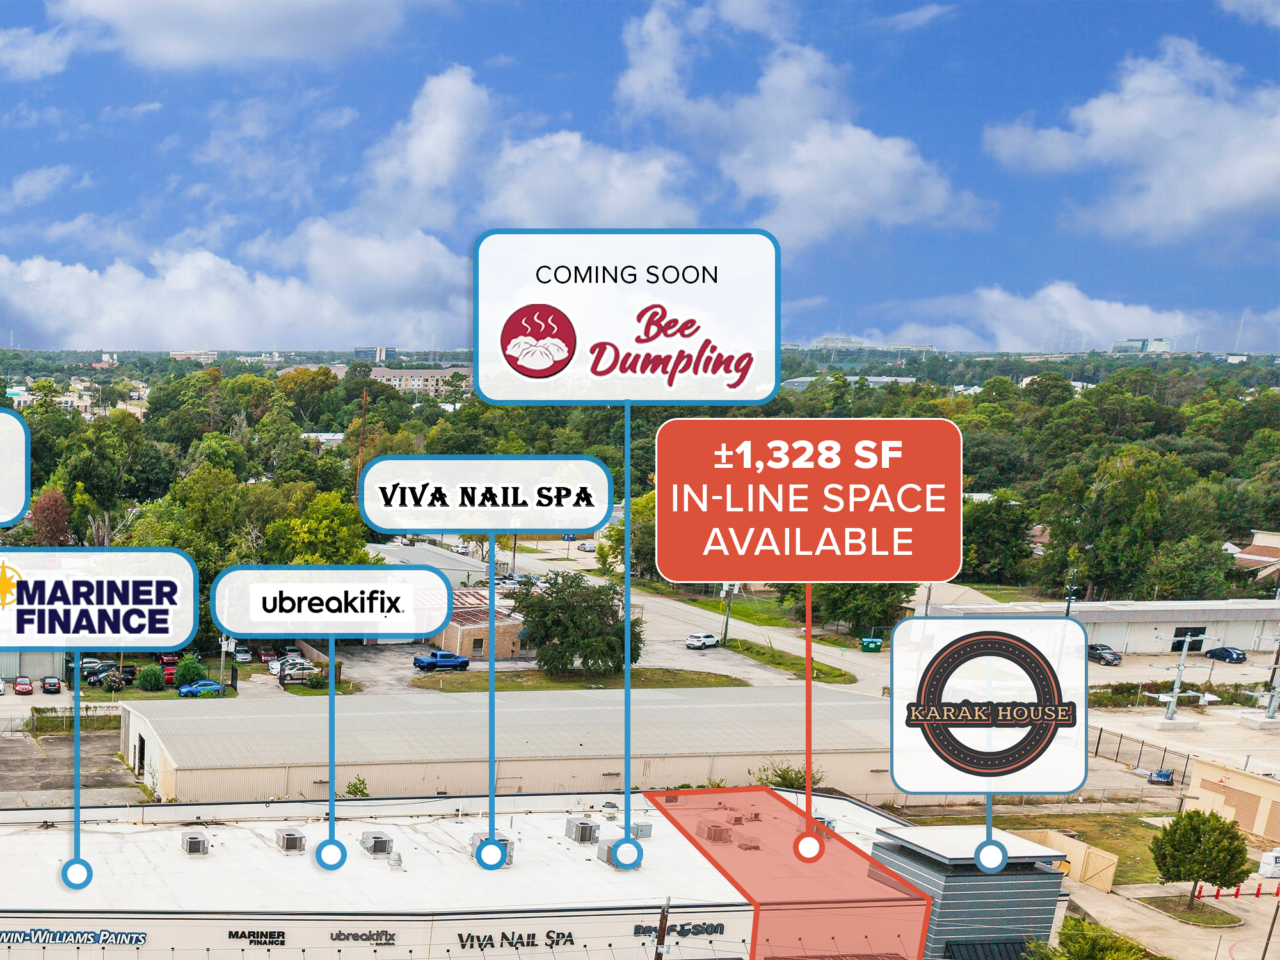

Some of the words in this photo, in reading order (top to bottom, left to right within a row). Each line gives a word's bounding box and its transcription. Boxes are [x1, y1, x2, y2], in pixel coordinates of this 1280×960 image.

[98, 929, 147, 945] PAINTS
[228, 930, 286, 940] MARINER
[330, 930, 396, 942] ubreakifix
[458, 932, 495, 949] VIVA
[500, 931, 538, 948] NAIL
[545, 930, 575, 947] SPA
